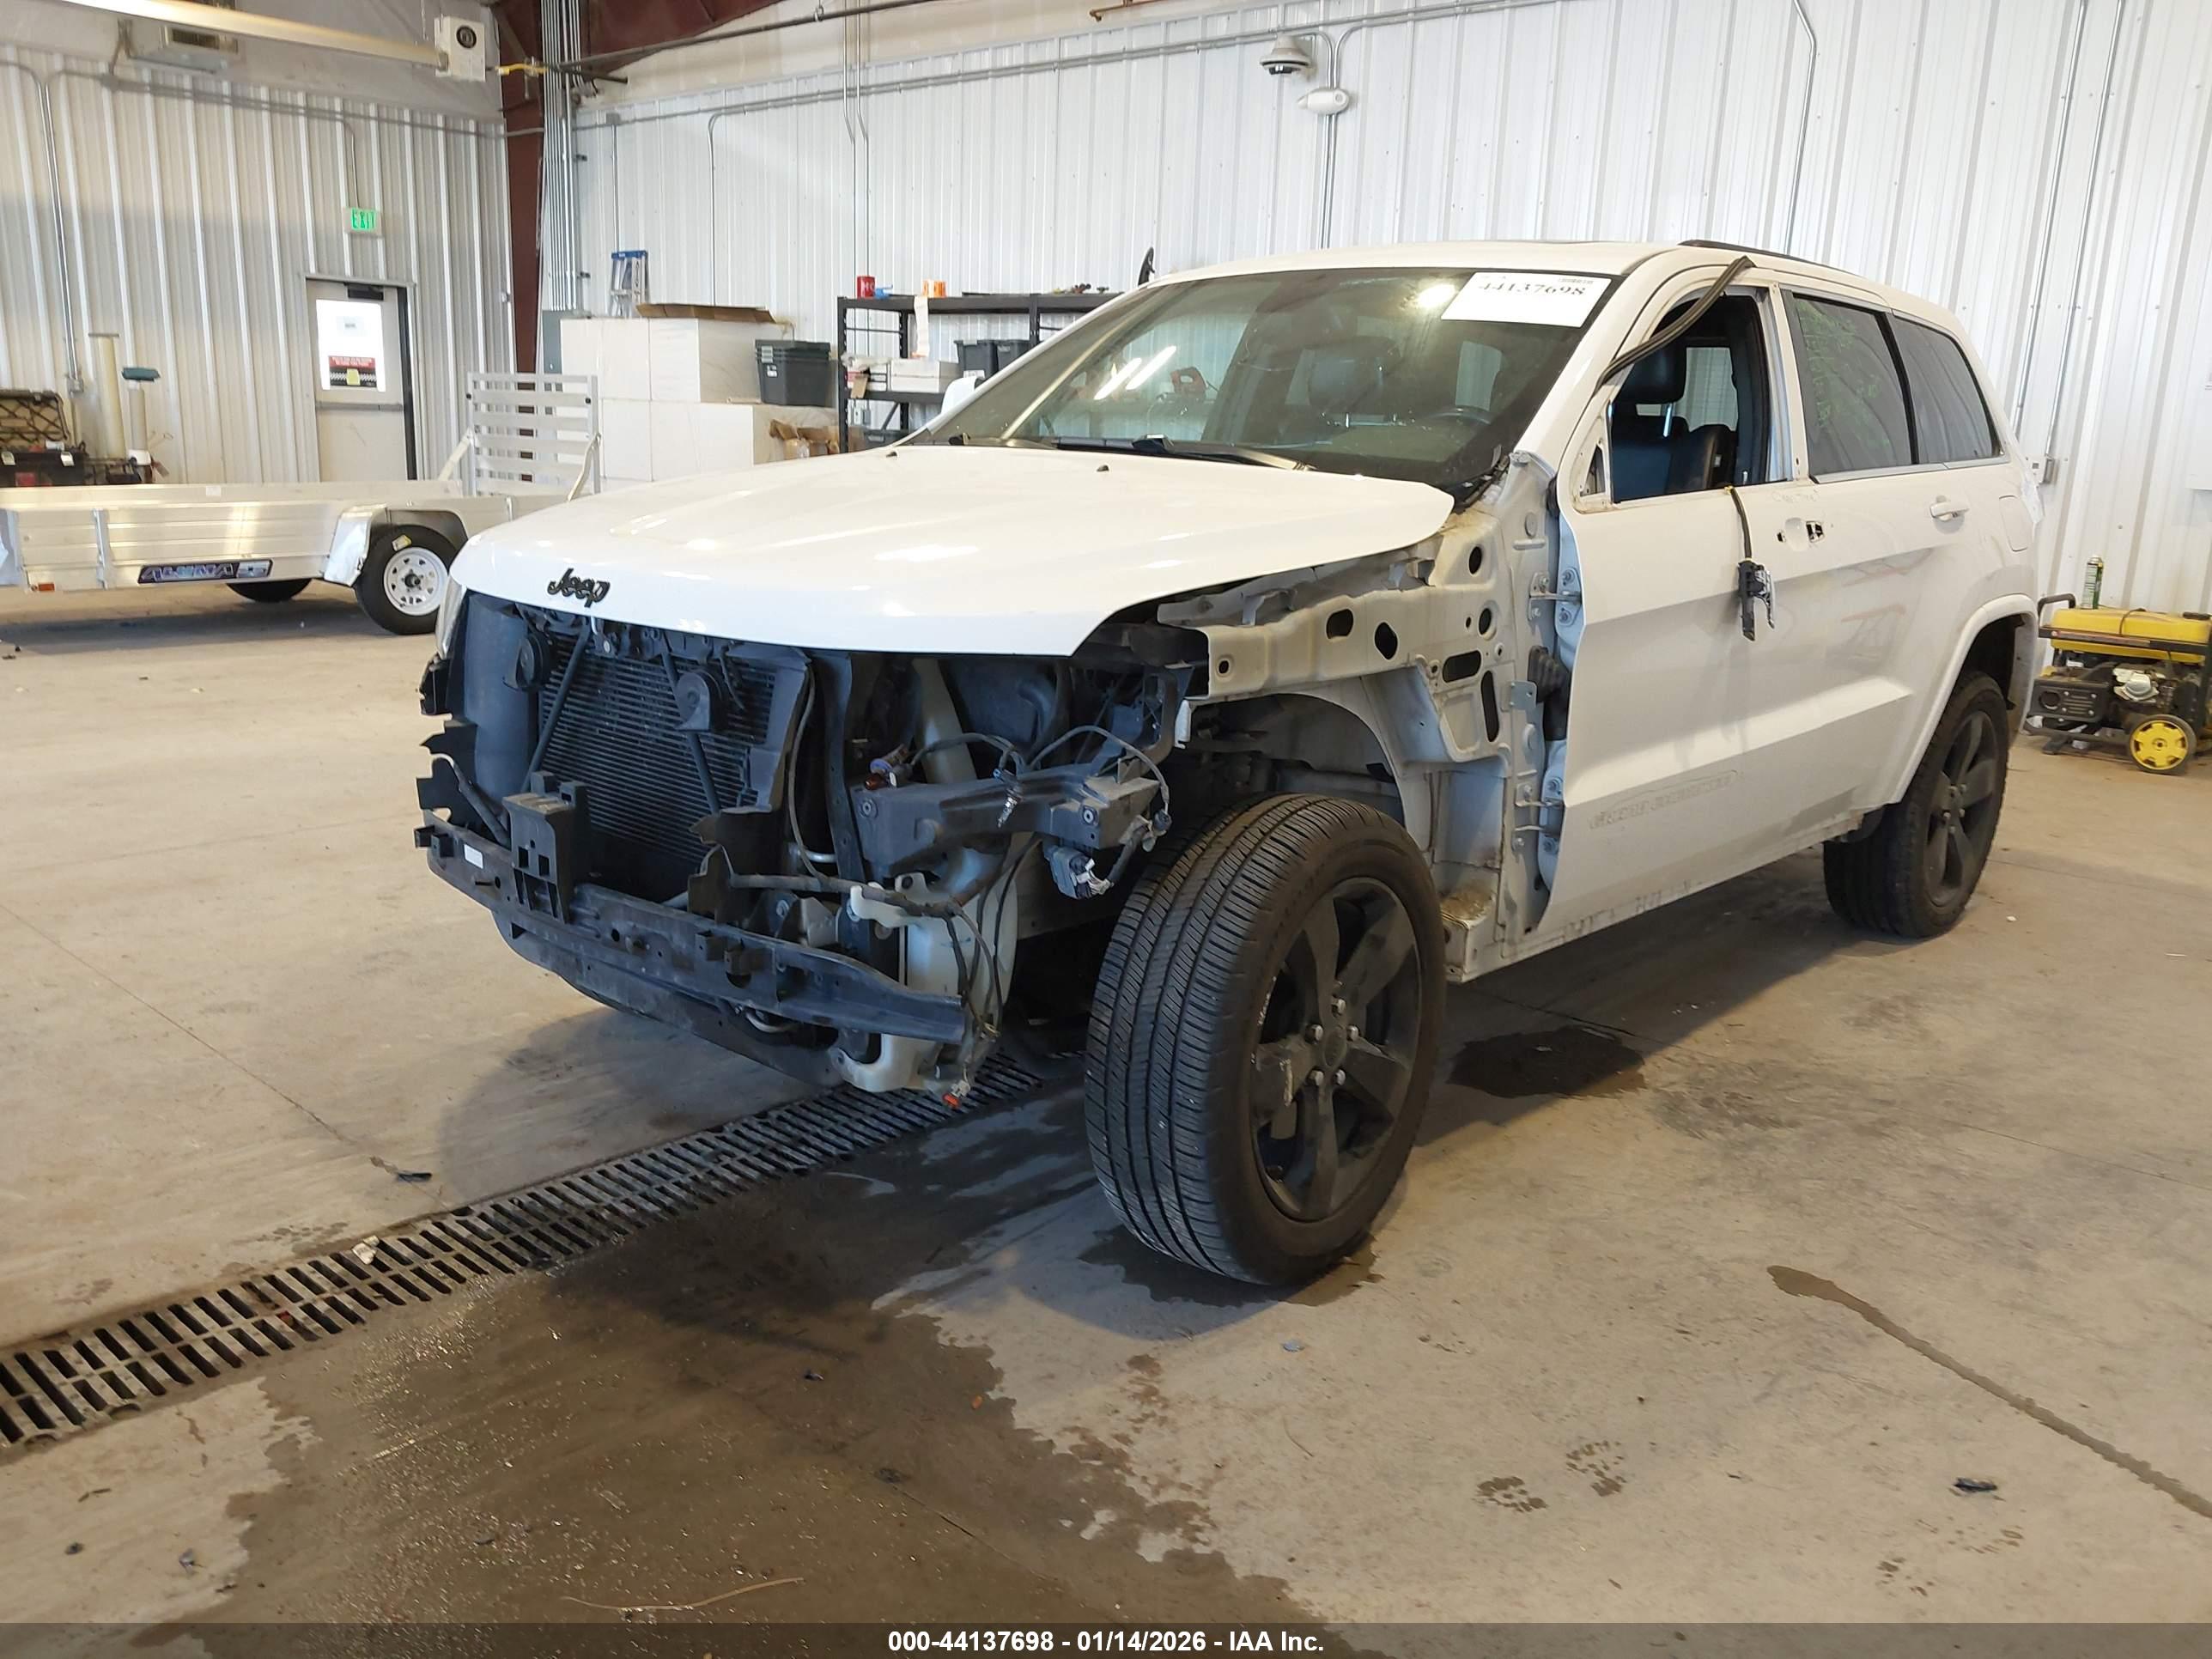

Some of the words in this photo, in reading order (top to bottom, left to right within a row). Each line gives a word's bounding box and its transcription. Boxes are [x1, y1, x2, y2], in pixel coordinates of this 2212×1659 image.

[351, 208, 374, 229] EXIT
[1478, 282, 1587, 295] 44137698
[547, 568, 611, 608] Jeep
